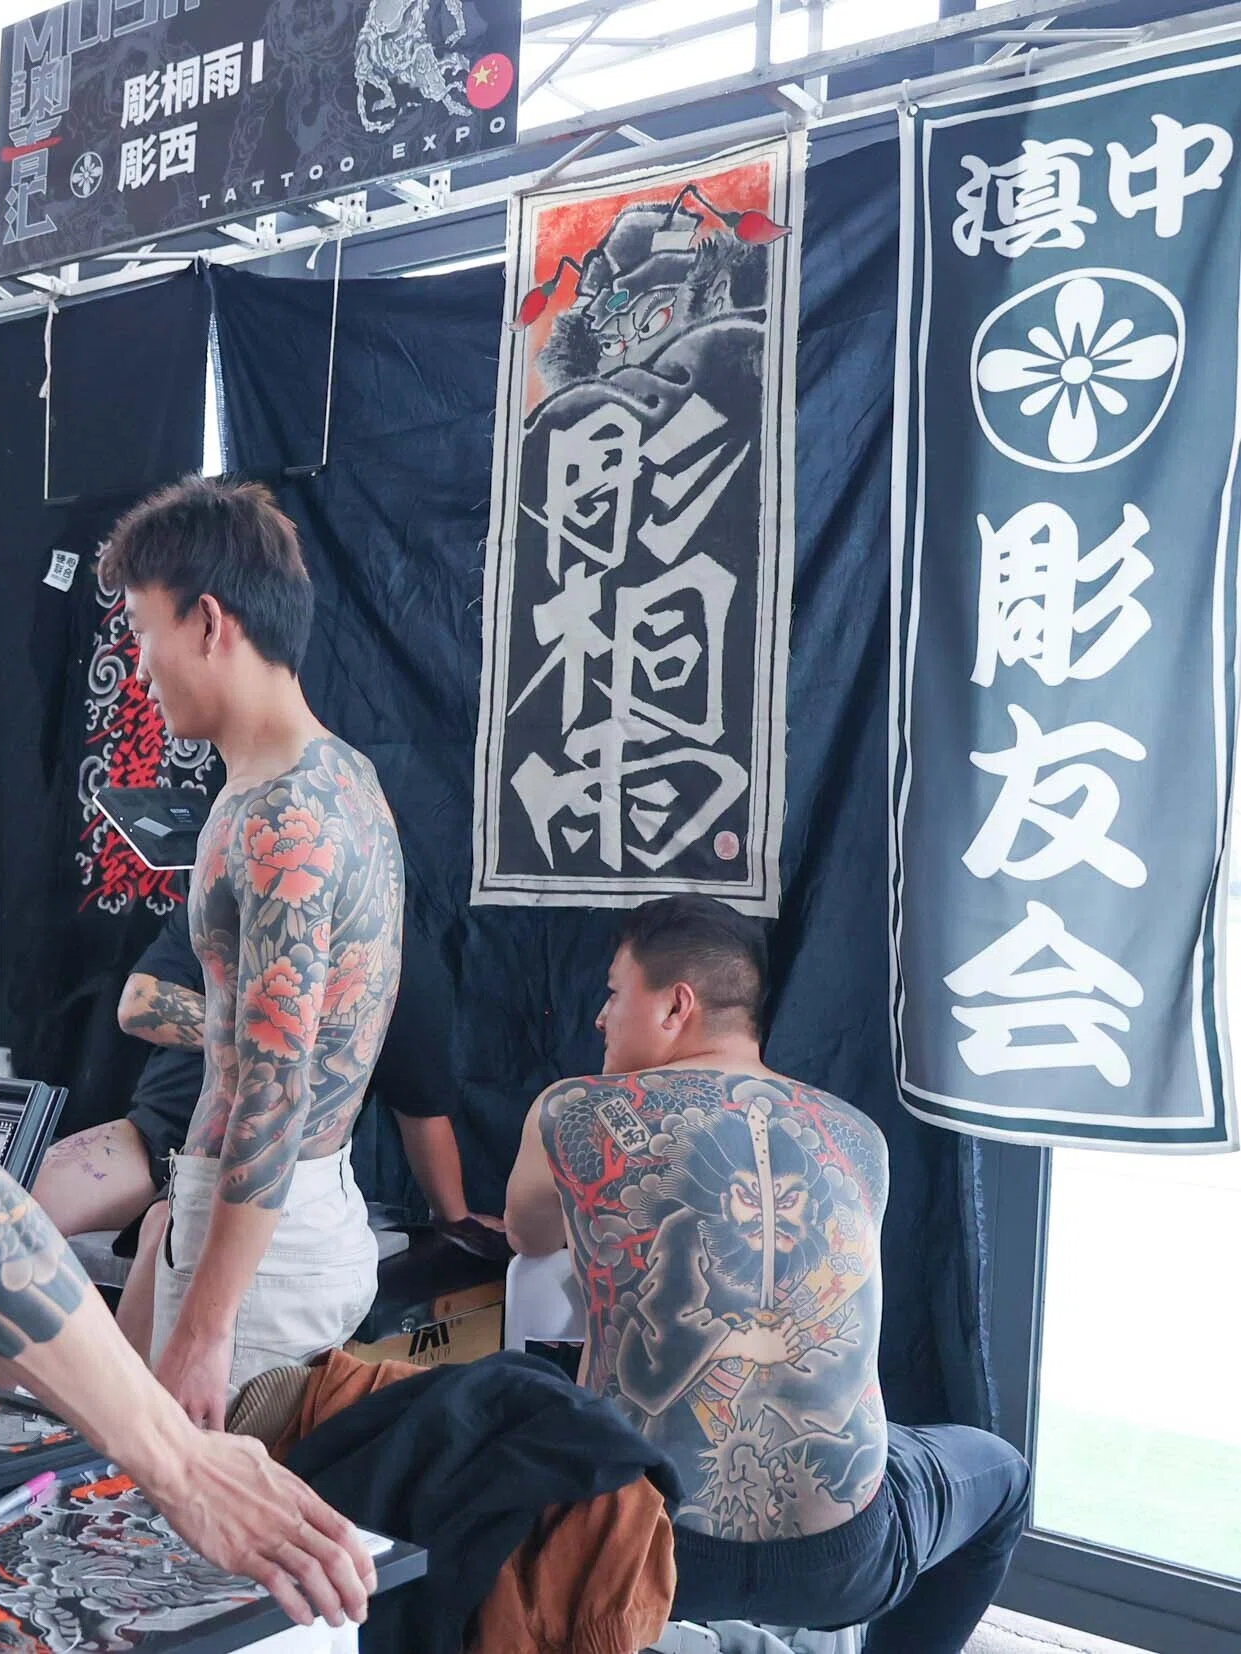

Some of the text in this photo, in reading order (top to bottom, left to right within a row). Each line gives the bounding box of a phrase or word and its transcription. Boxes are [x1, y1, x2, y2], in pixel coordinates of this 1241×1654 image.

[117, 121, 198, 193] 彫西
[198, 116, 506, 208] TATTOO EXPO
[942, 500, 1154, 1087] 彫友会
